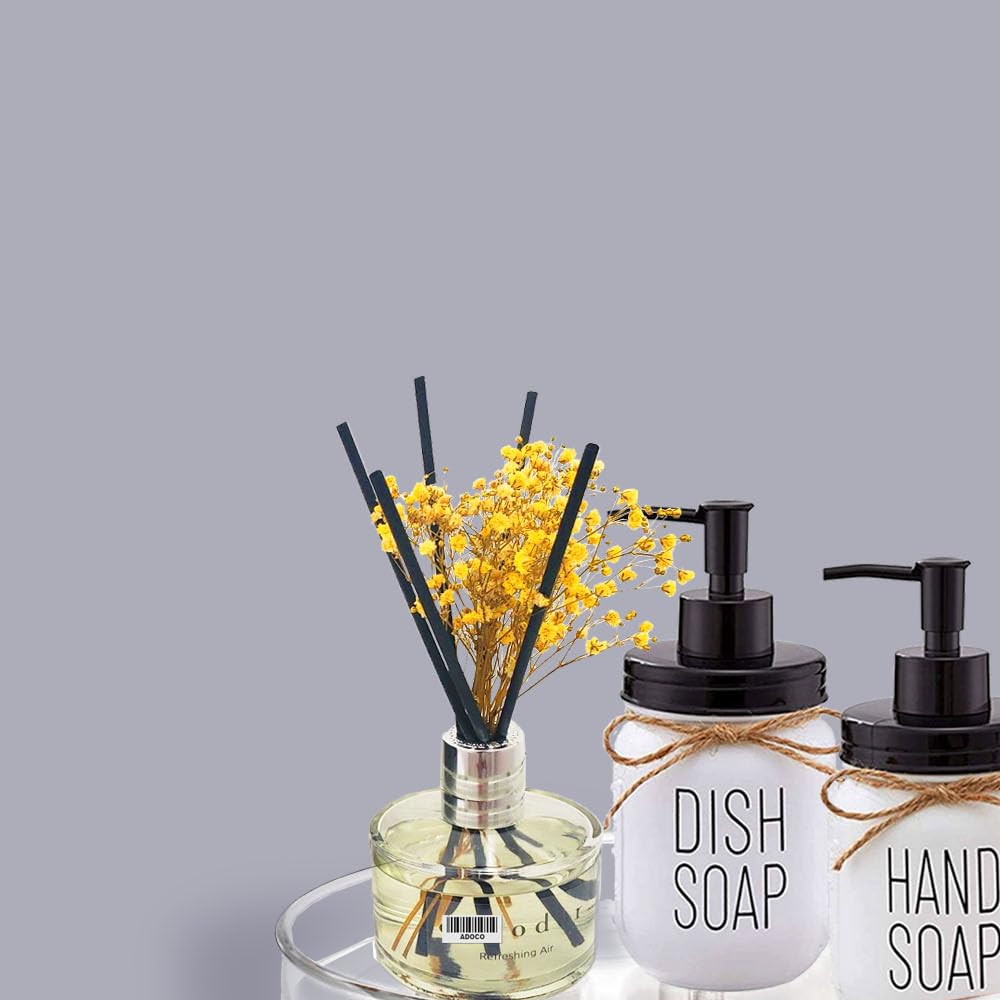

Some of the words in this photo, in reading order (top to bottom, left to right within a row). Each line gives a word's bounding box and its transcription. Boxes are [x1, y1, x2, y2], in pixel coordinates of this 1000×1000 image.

[676, 787, 785, 855] DISH
[675, 863, 787, 931] SOAP
[888, 847, 1000, 915] HAND
[479, 948, 537, 961] Refreshing
[540, 945, 554, 954] Air
